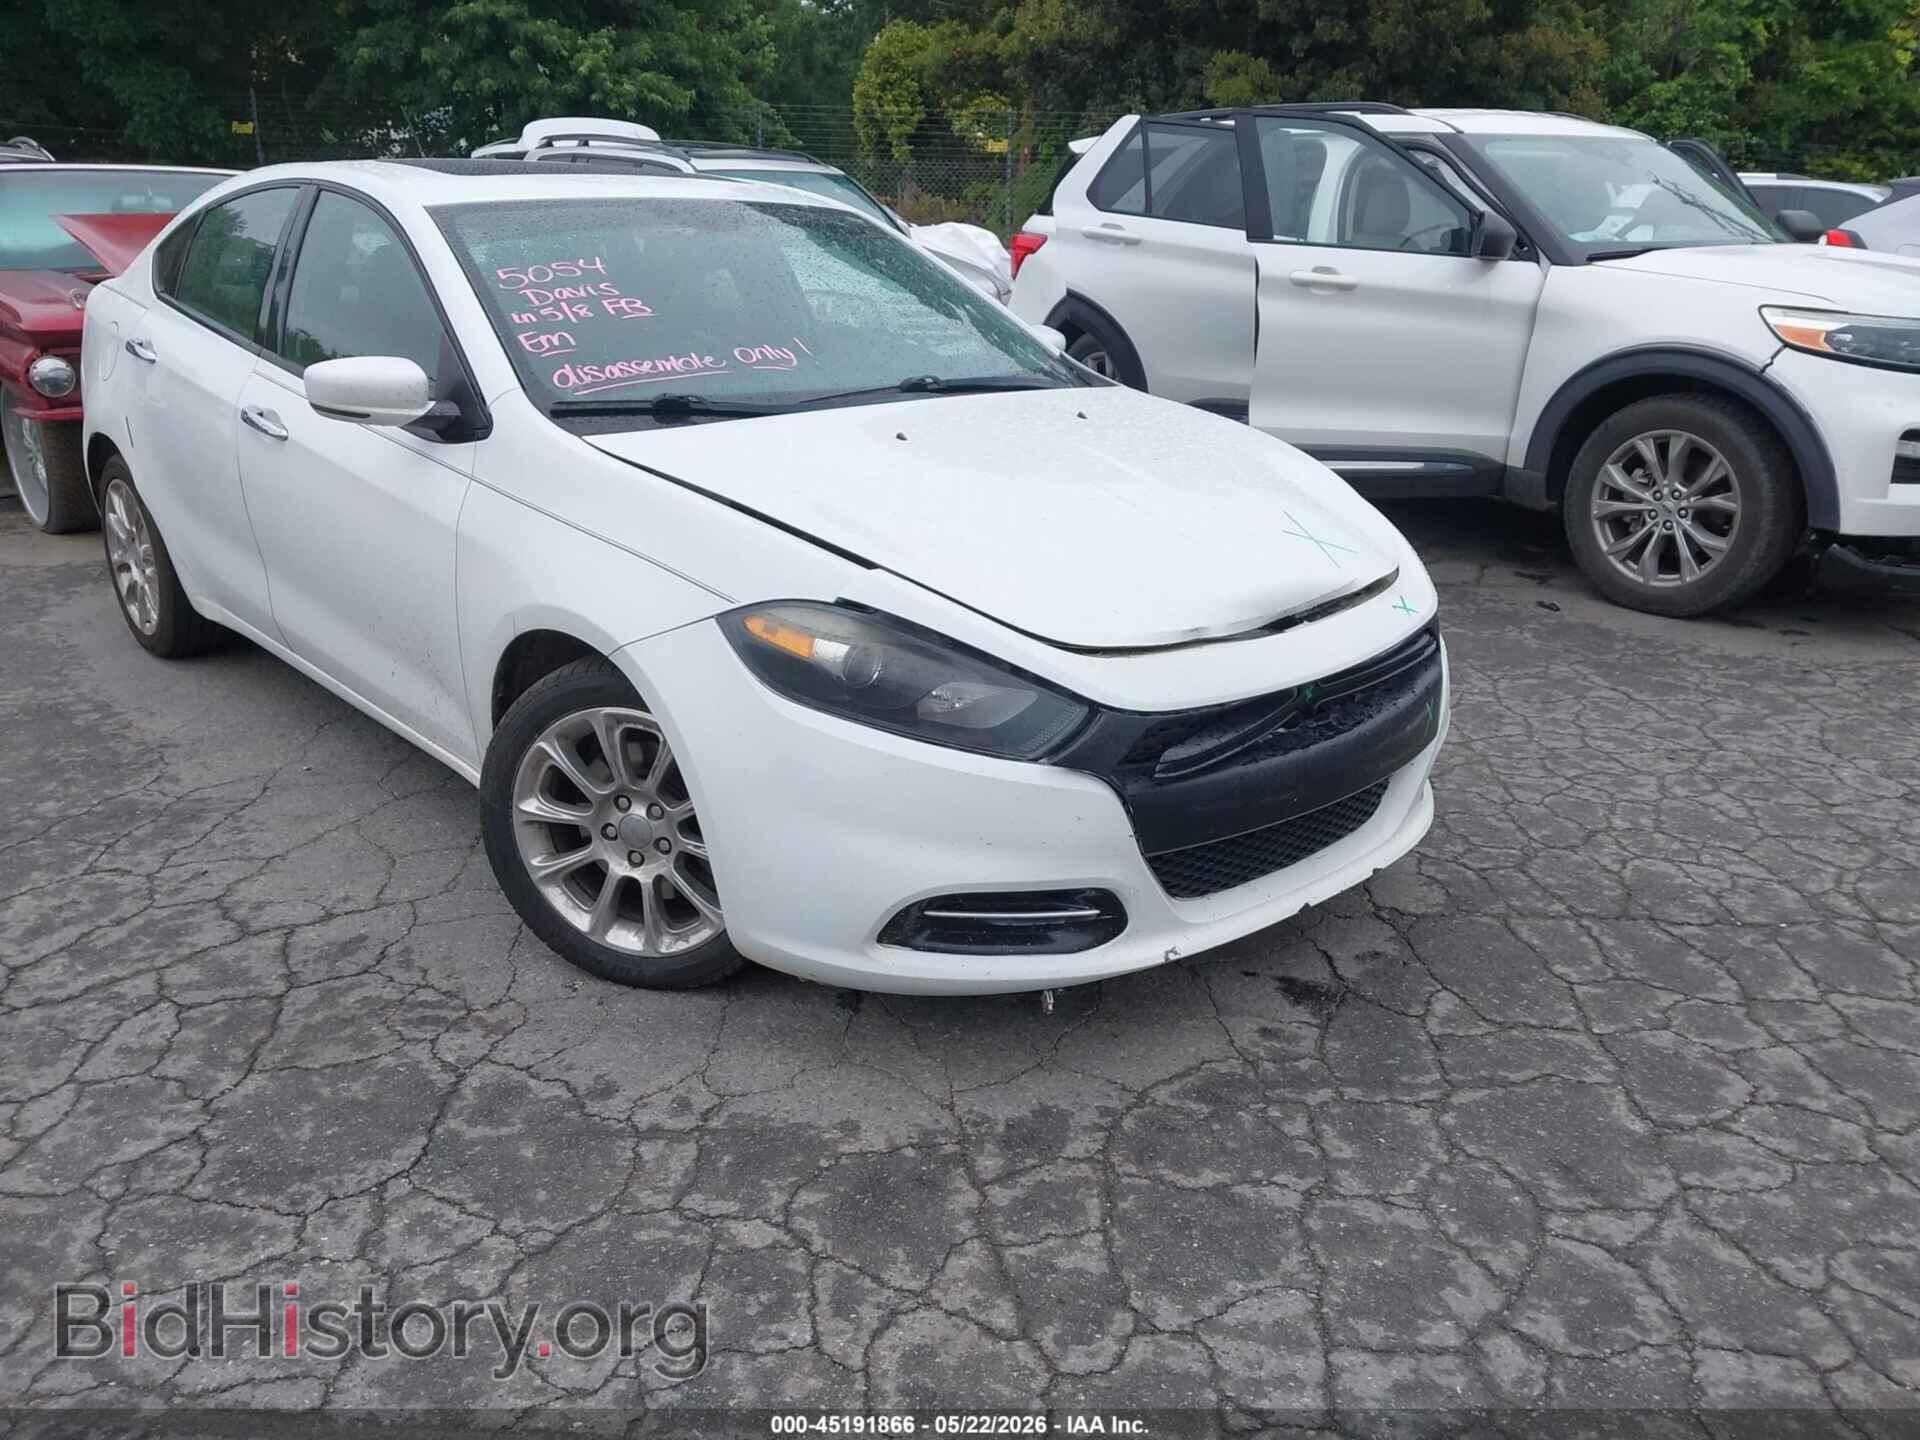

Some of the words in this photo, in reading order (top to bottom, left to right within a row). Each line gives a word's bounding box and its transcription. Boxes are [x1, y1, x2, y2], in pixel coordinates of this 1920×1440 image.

[496, 256, 606, 289] 5054
[518, 282, 620, 307] Davis
[539, 302, 594, 324] 5/8
